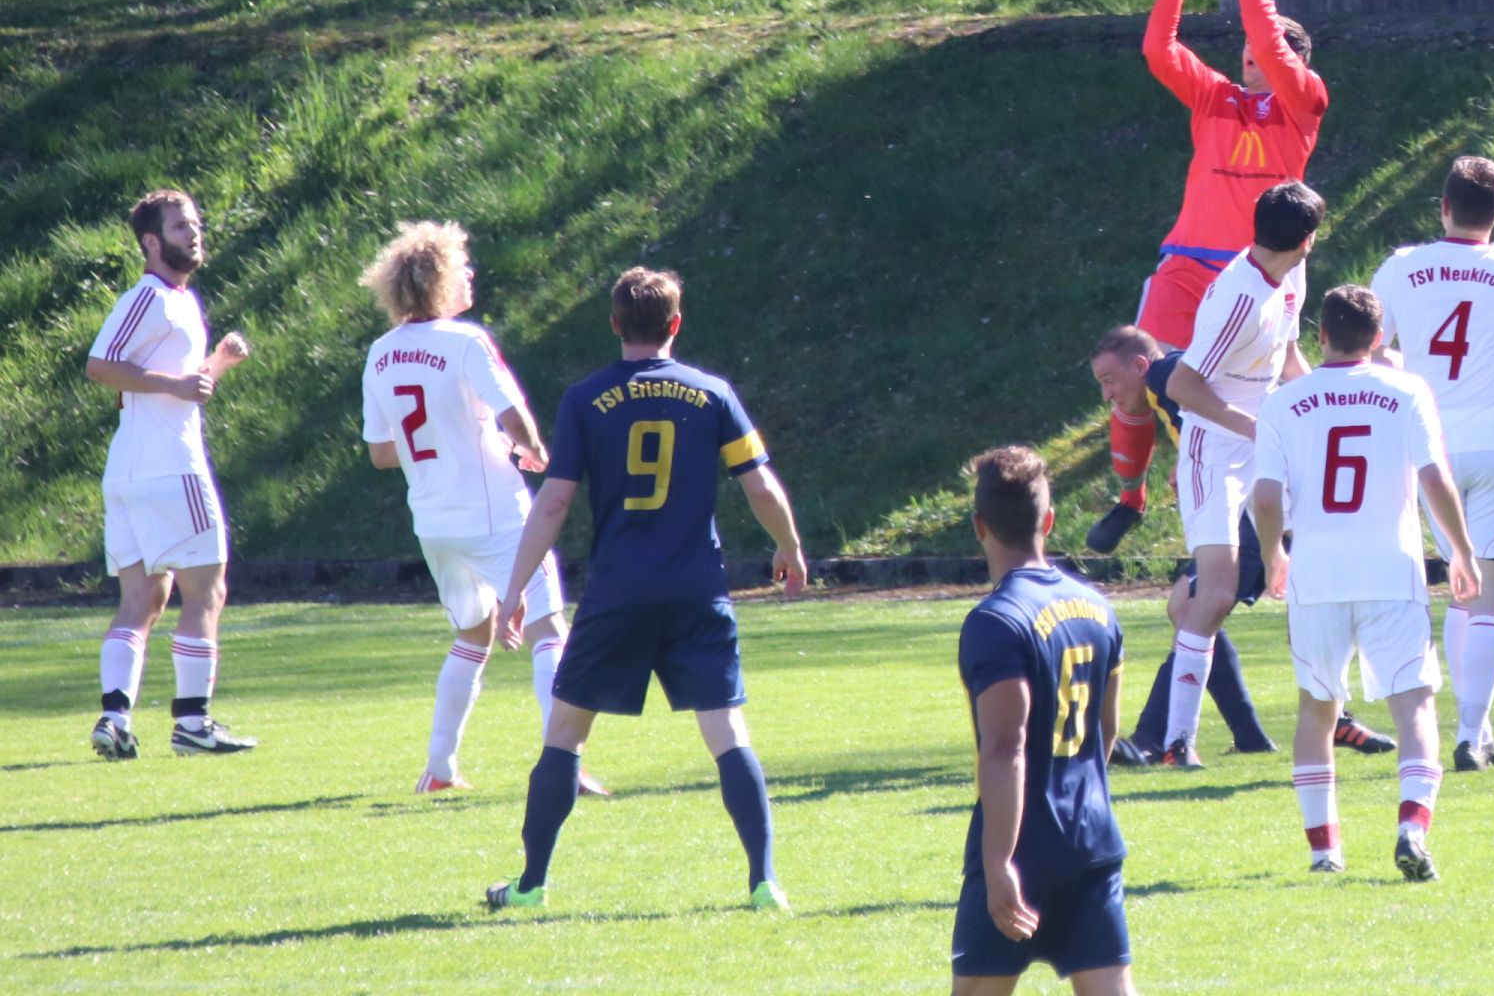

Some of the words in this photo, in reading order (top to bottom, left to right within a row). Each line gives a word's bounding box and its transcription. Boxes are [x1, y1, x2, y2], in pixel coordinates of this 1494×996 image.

[1408, 267, 1435, 288] TSV
[392, 348, 448, 373] Neukirch
[1428, 300, 1473, 381] 4
[393, 385, 438, 462] 2
[592, 385, 625, 414] TSV
[627, 380, 710, 409] Eriskirch
[1289, 393, 1320, 417] TSV
[1324, 390, 1399, 414] Neukirch
[623, 419, 676, 511] 9
[1321, 424, 1372, 514] 6
